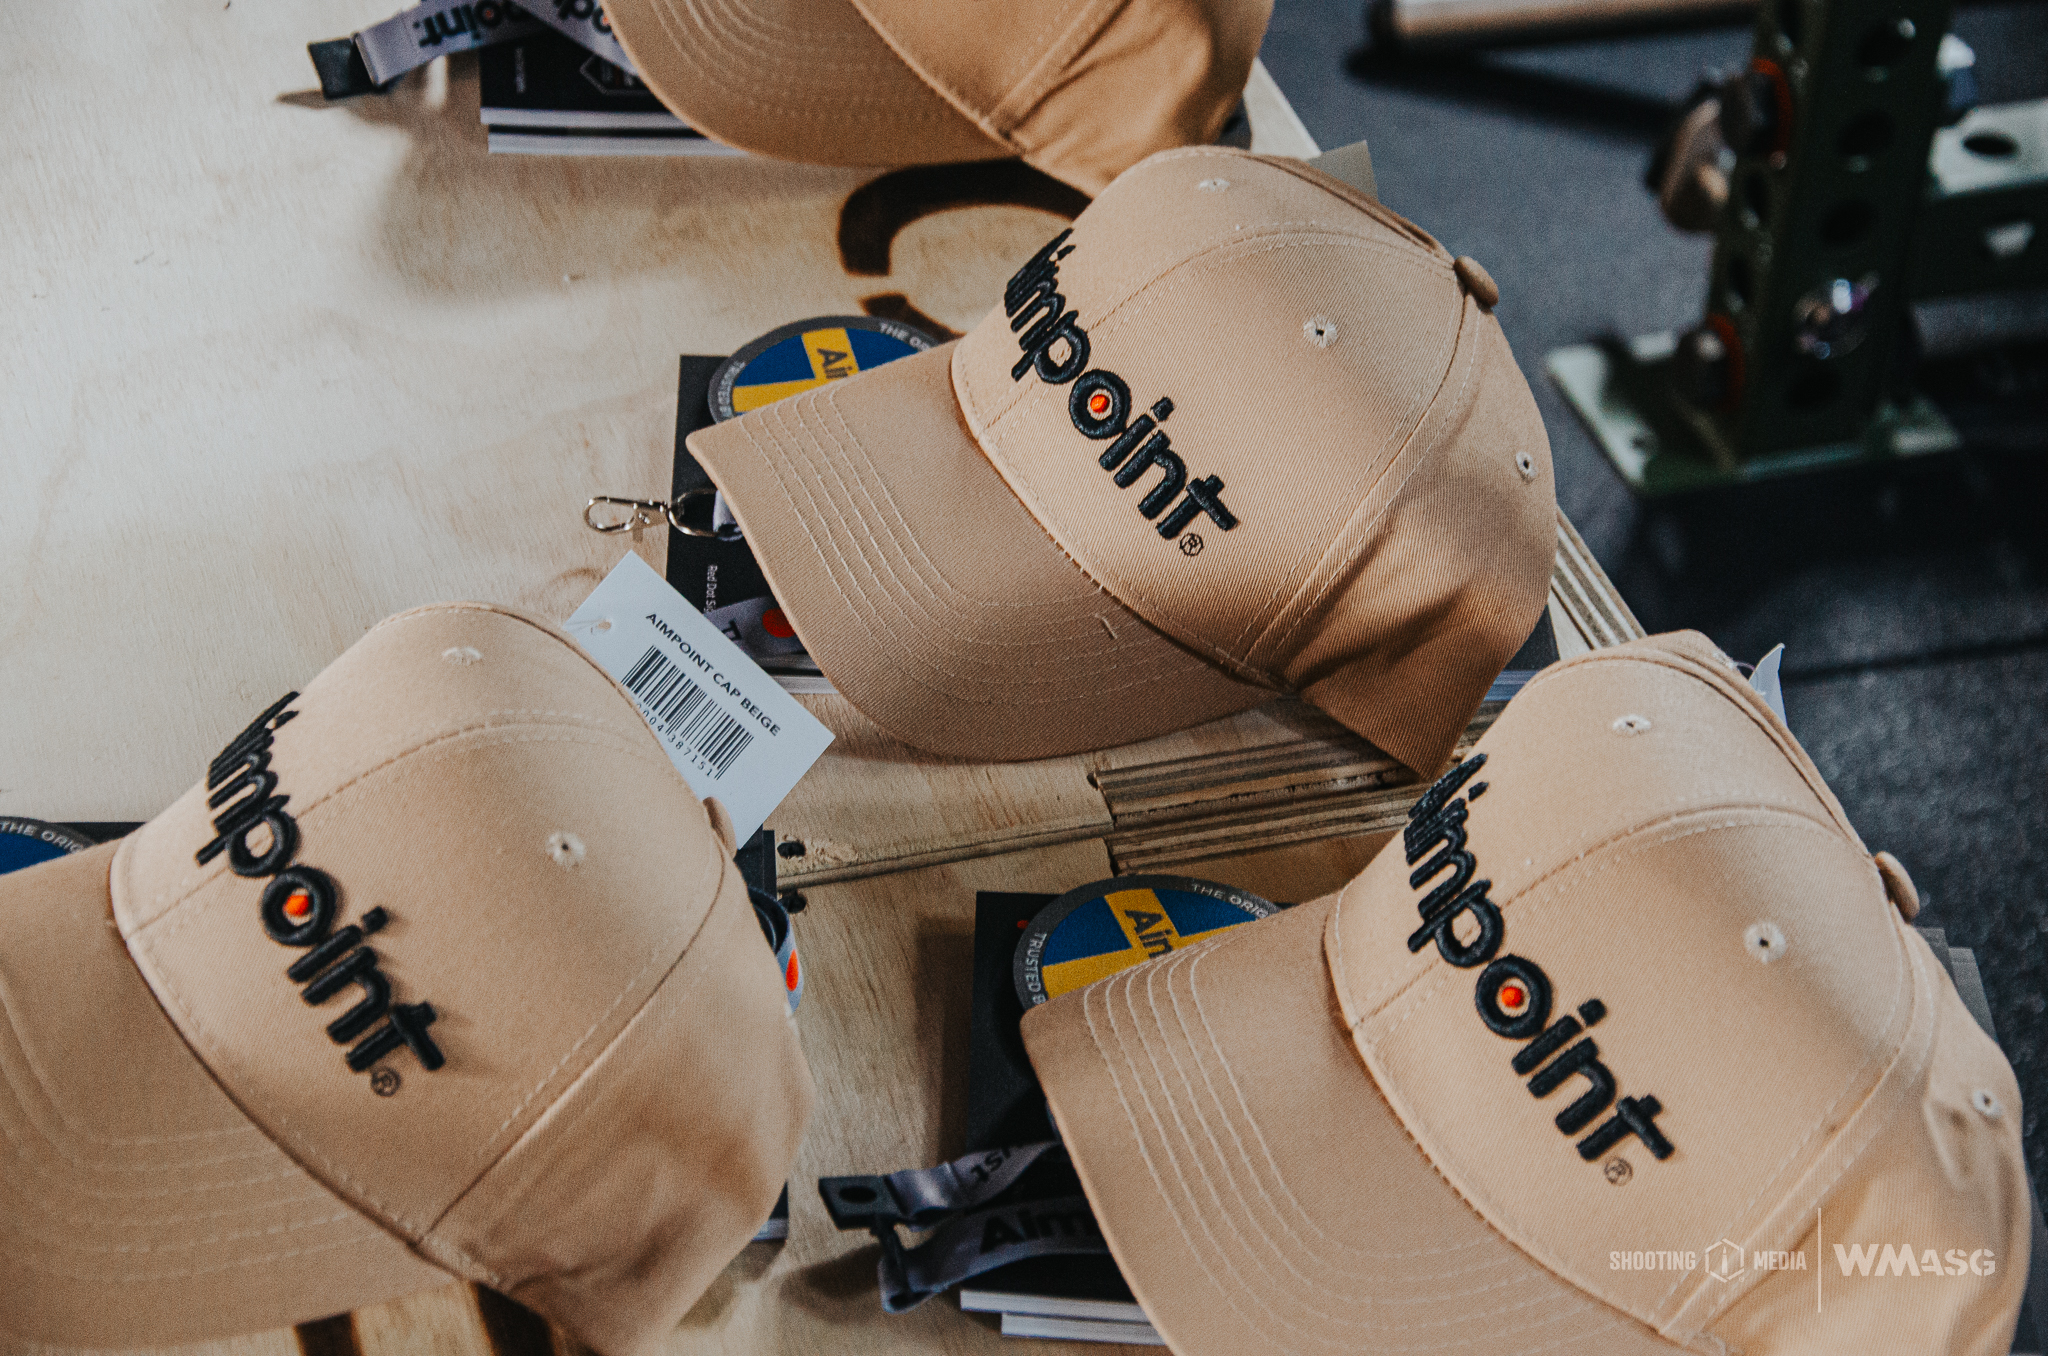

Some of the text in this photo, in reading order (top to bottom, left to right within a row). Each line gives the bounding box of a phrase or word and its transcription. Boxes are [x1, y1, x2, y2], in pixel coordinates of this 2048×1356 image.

[879, 322, 909, 341] THE
[706, 583, 717, 598] Dot
[645, 612, 714, 674] AIMPOINT
[712, 672, 742, 700] CAP
[740, 696, 781, 737] BEIGE
[0, 820, 38, 837] THE
[1190, 882, 1225, 899] THE
[1025, 931, 1047, 993] TRUSTED
